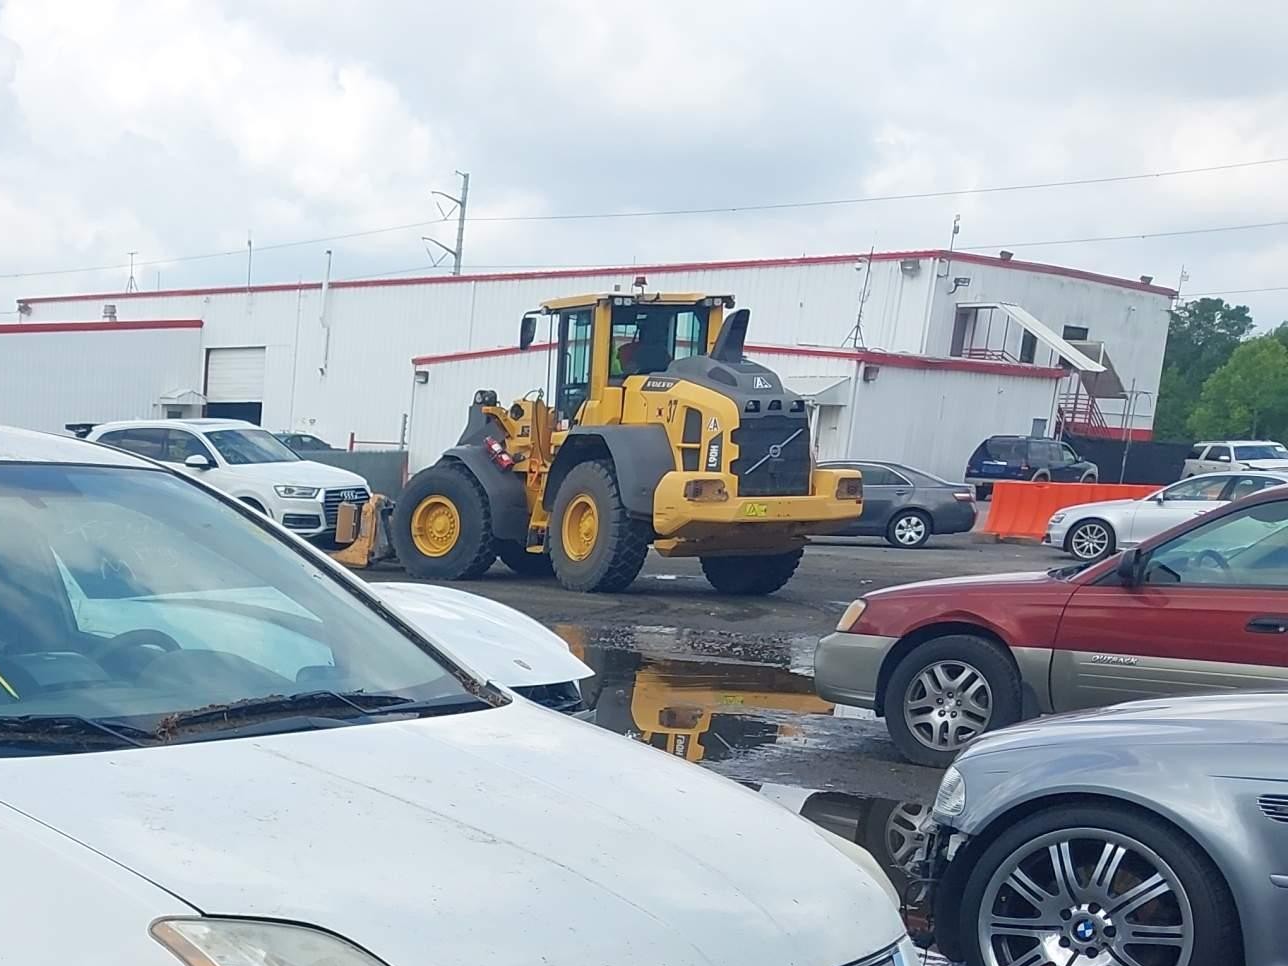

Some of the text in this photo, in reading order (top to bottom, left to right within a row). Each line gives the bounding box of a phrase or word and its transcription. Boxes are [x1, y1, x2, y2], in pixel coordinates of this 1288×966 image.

[666, 399, 679, 424] 37
[707, 444, 720, 468] L90H
[1091, 655, 1138, 666] OUTBACK
